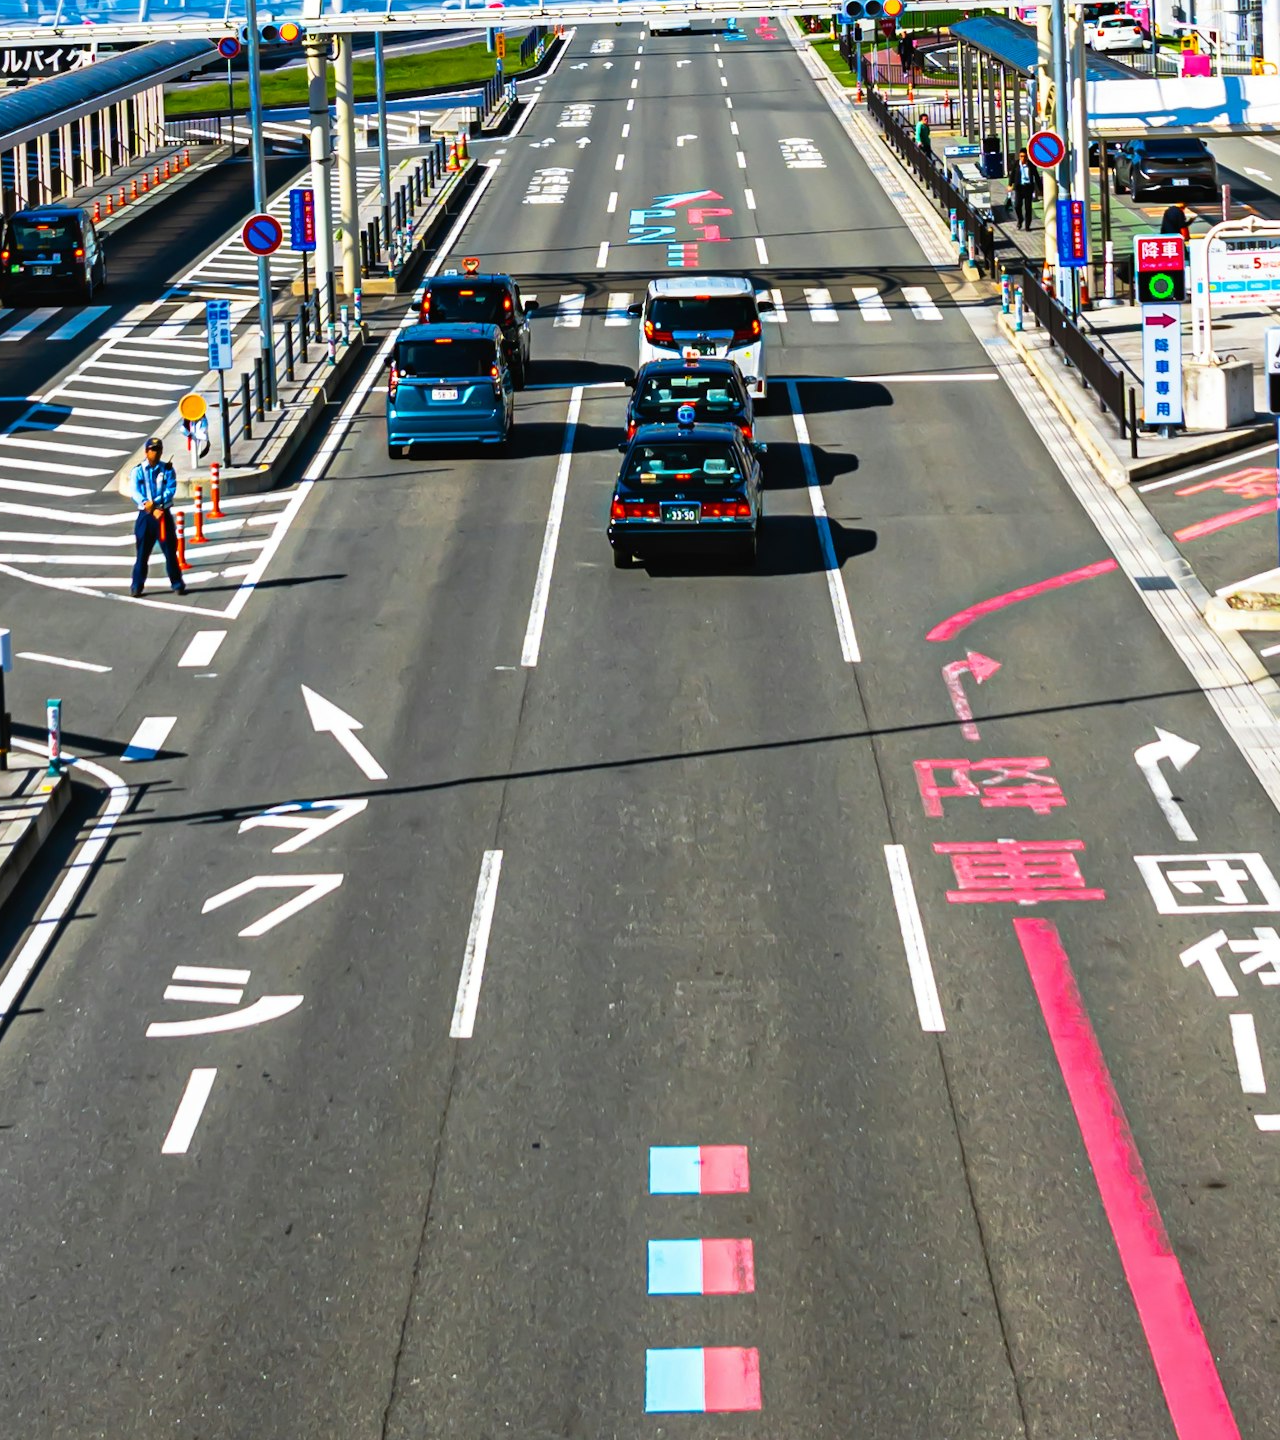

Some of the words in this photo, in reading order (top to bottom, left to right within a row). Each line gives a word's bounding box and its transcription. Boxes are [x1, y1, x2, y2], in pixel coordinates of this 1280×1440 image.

[1141, 241, 1179, 259] 降車
[913, 755, 1106, 905] 降車
[145, 799, 368, 1154] タクシー
